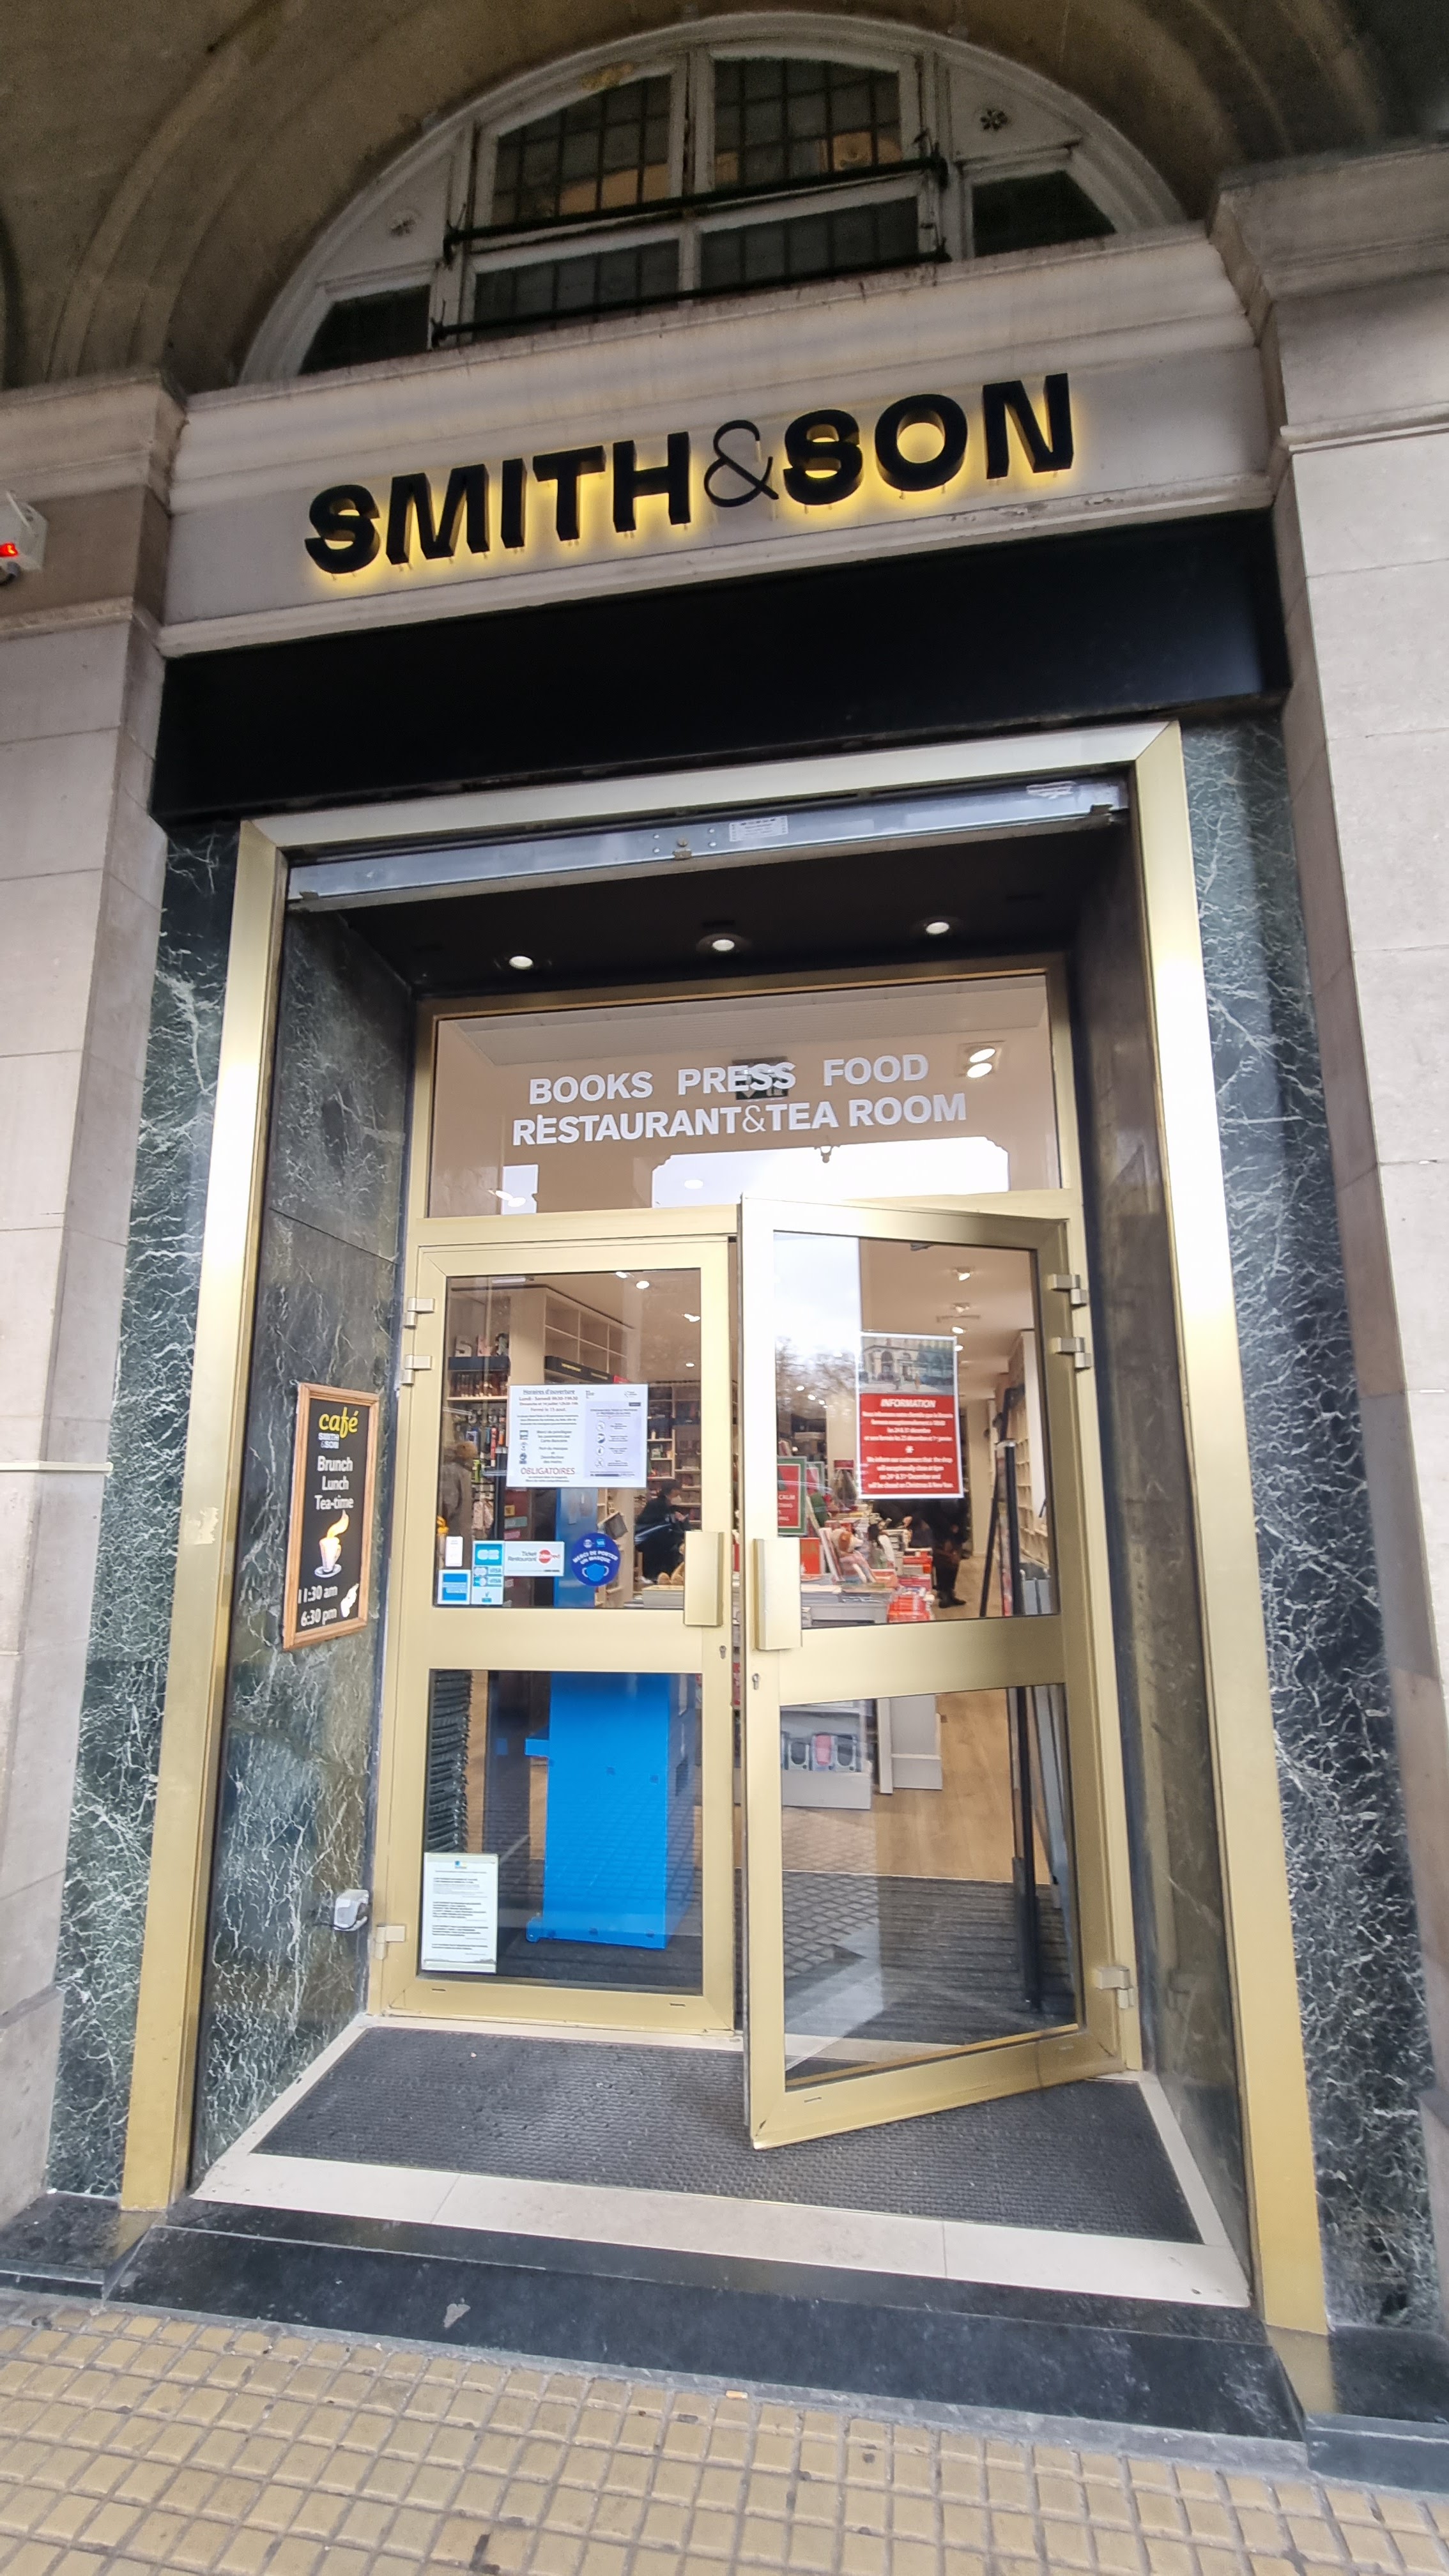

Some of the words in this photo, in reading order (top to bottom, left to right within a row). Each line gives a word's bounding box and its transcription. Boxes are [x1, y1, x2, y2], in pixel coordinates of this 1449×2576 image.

[529, 1071, 654, 1105] BOOKS
[677, 1061, 797, 1096] PRESS
[823, 1054, 929, 1087] FOOD
[848, 1092, 967, 1128] ROOM
[319, 1406, 359, 1438] café
[317, 1455, 353, 1471] Brunch
[321, 1475, 349, 1491] Lunch
[314, 1494, 354, 1510] Tea-time
[298, 1585, 323, 1604] 11:30
[323, 1586, 338, 1598] am
[300, 1608, 321, 1627] 6:30
[322, 1608, 337, 1625] pm
